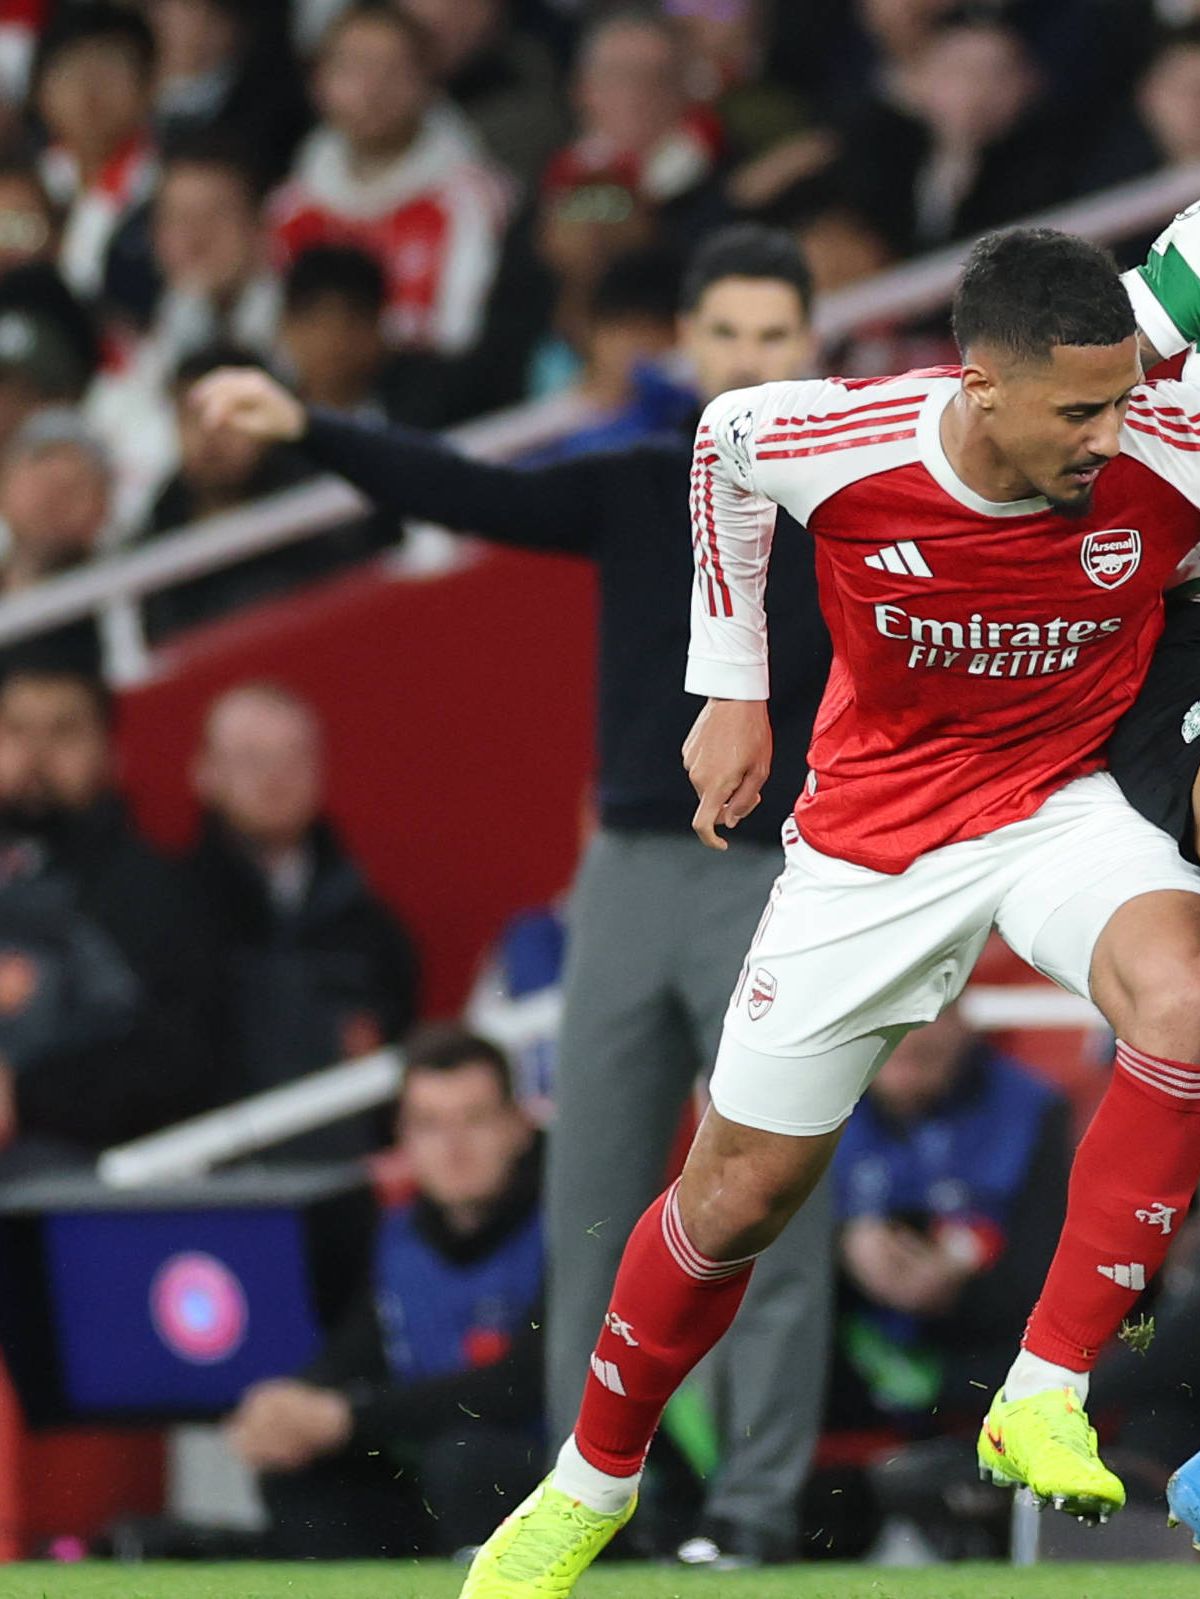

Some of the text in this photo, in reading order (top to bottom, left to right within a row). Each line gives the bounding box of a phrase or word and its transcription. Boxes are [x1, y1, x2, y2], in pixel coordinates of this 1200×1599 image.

[1091, 539, 1133, 553] Arsenal
[874, 602, 1122, 649] Emirates
[908, 645, 1079, 677] FLY BETTER
